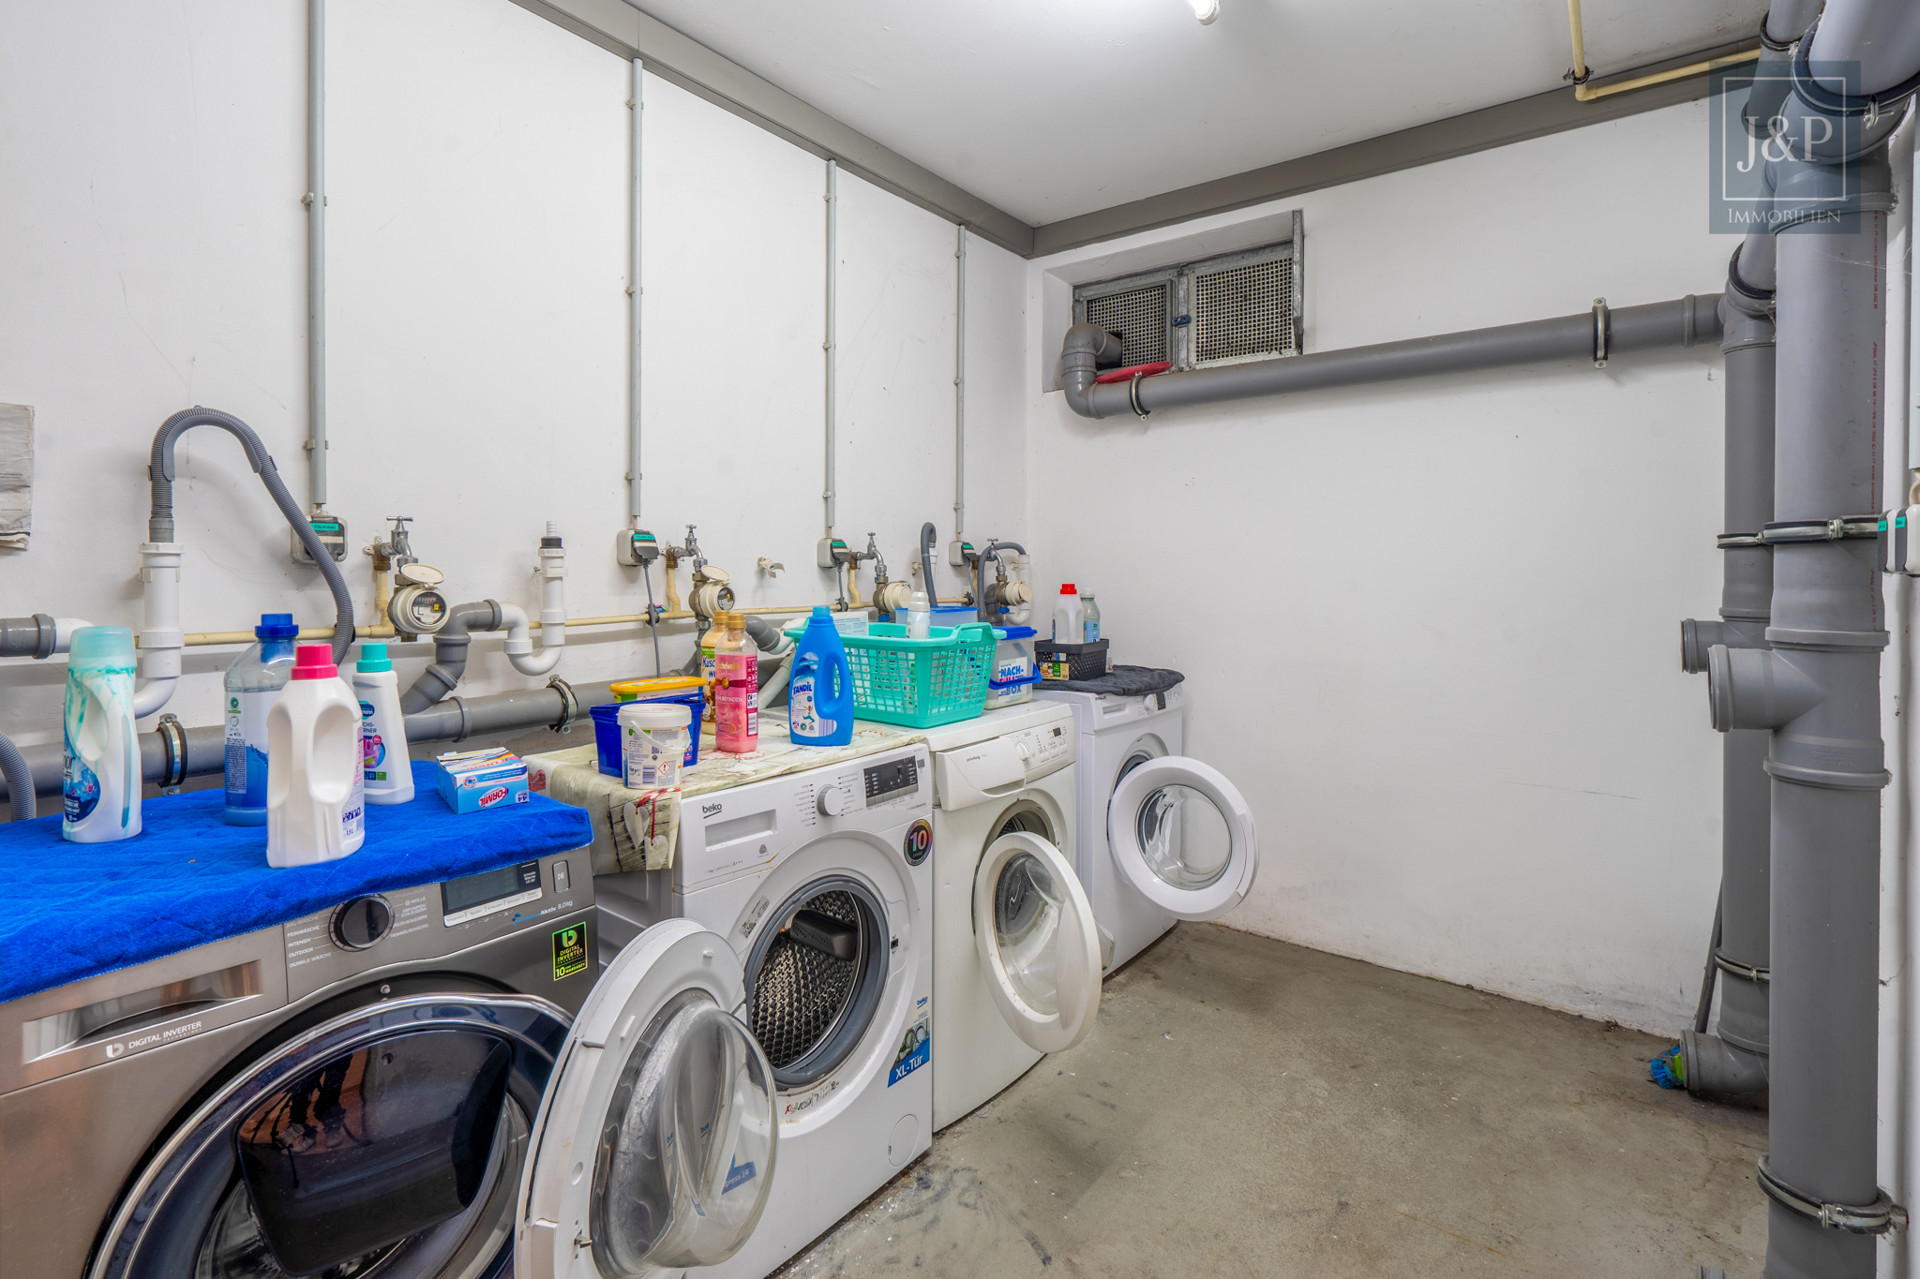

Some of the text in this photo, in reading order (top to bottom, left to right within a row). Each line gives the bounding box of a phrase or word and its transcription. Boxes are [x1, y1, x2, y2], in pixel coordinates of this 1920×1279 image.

[1000, 665, 1024, 678] NACH-
[702, 803, 722, 814] beko
[909, 829, 927, 852] 10
[557, 948, 584, 963] INVERTER
[560, 944, 581, 956] DIGITAL
[556, 966, 566, 978] 10
[128, 1021, 202, 1049] DIGITAL INVERTER
[896, 1055, 924, 1080] XL-Tür
